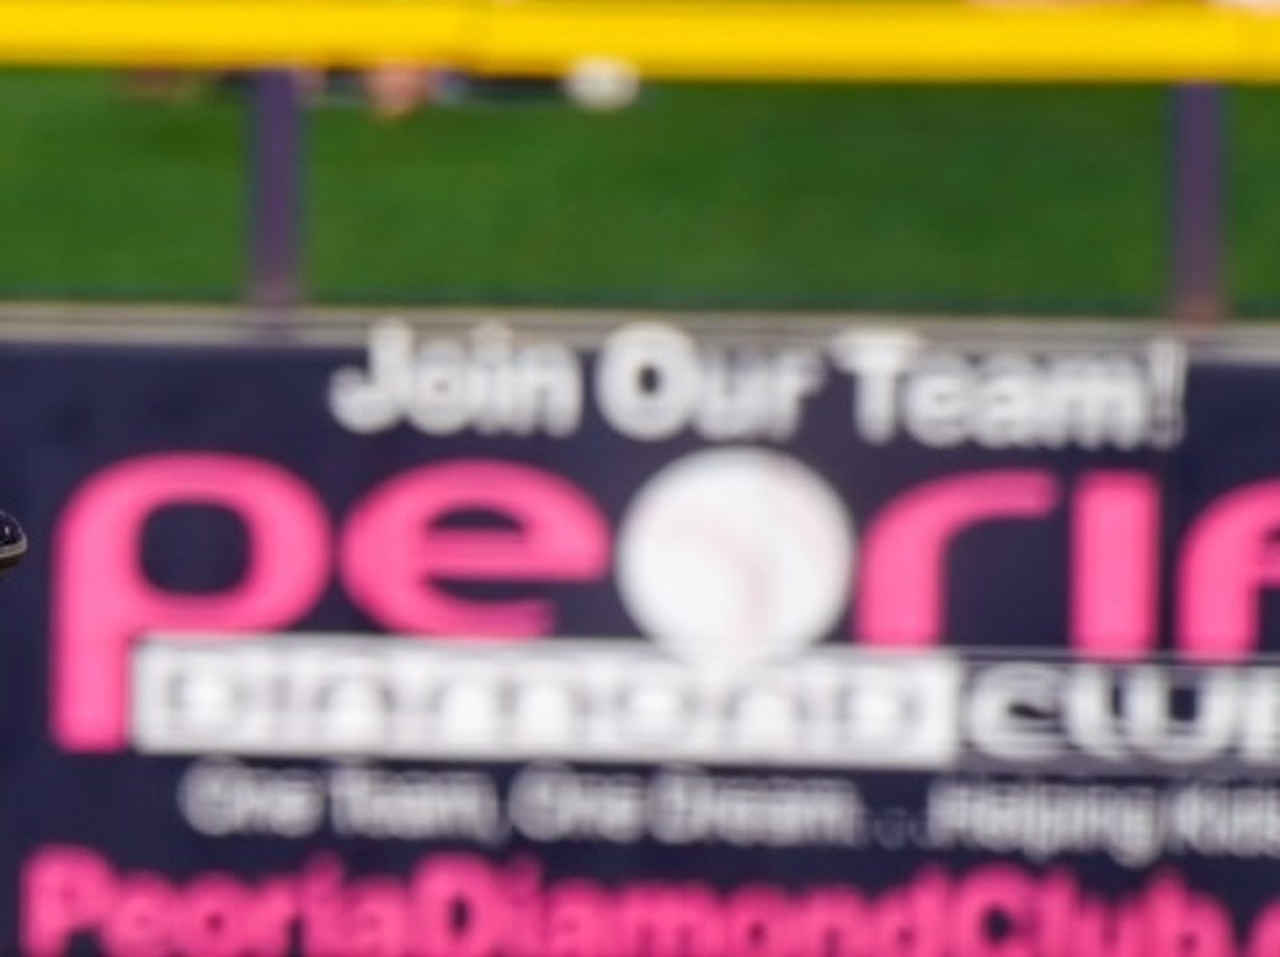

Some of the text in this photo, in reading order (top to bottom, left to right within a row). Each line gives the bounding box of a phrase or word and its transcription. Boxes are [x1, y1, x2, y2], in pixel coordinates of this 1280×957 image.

[332, 323, 1188, 449] Join Our Team!
